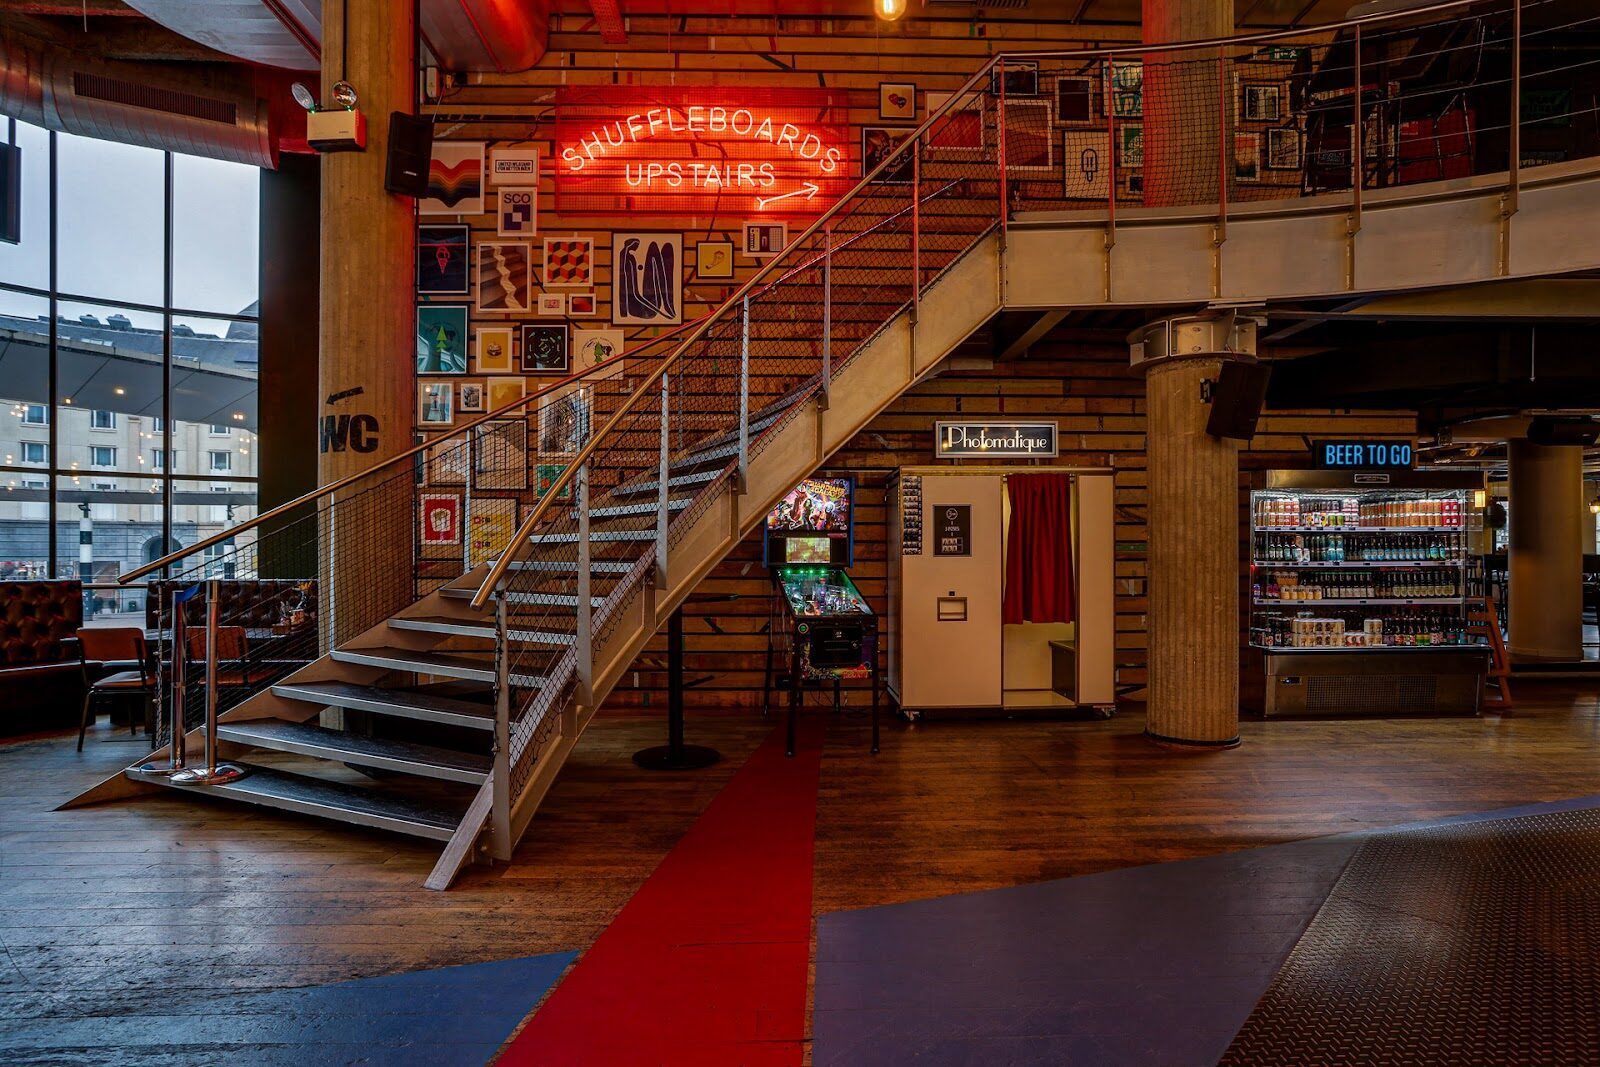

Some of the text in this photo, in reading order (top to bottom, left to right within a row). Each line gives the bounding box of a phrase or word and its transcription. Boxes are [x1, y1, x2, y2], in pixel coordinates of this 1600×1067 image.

[562, 106, 840, 172] SHUFFLEBOARDS
[625, 163, 776, 187] UPSTAIRS
[504, 193, 531, 204] SCO
[320, 414, 379, 454] WC
[948, 426, 1047, 453] Photomatique
[1326, 444, 1411, 465] BEER TO GO
